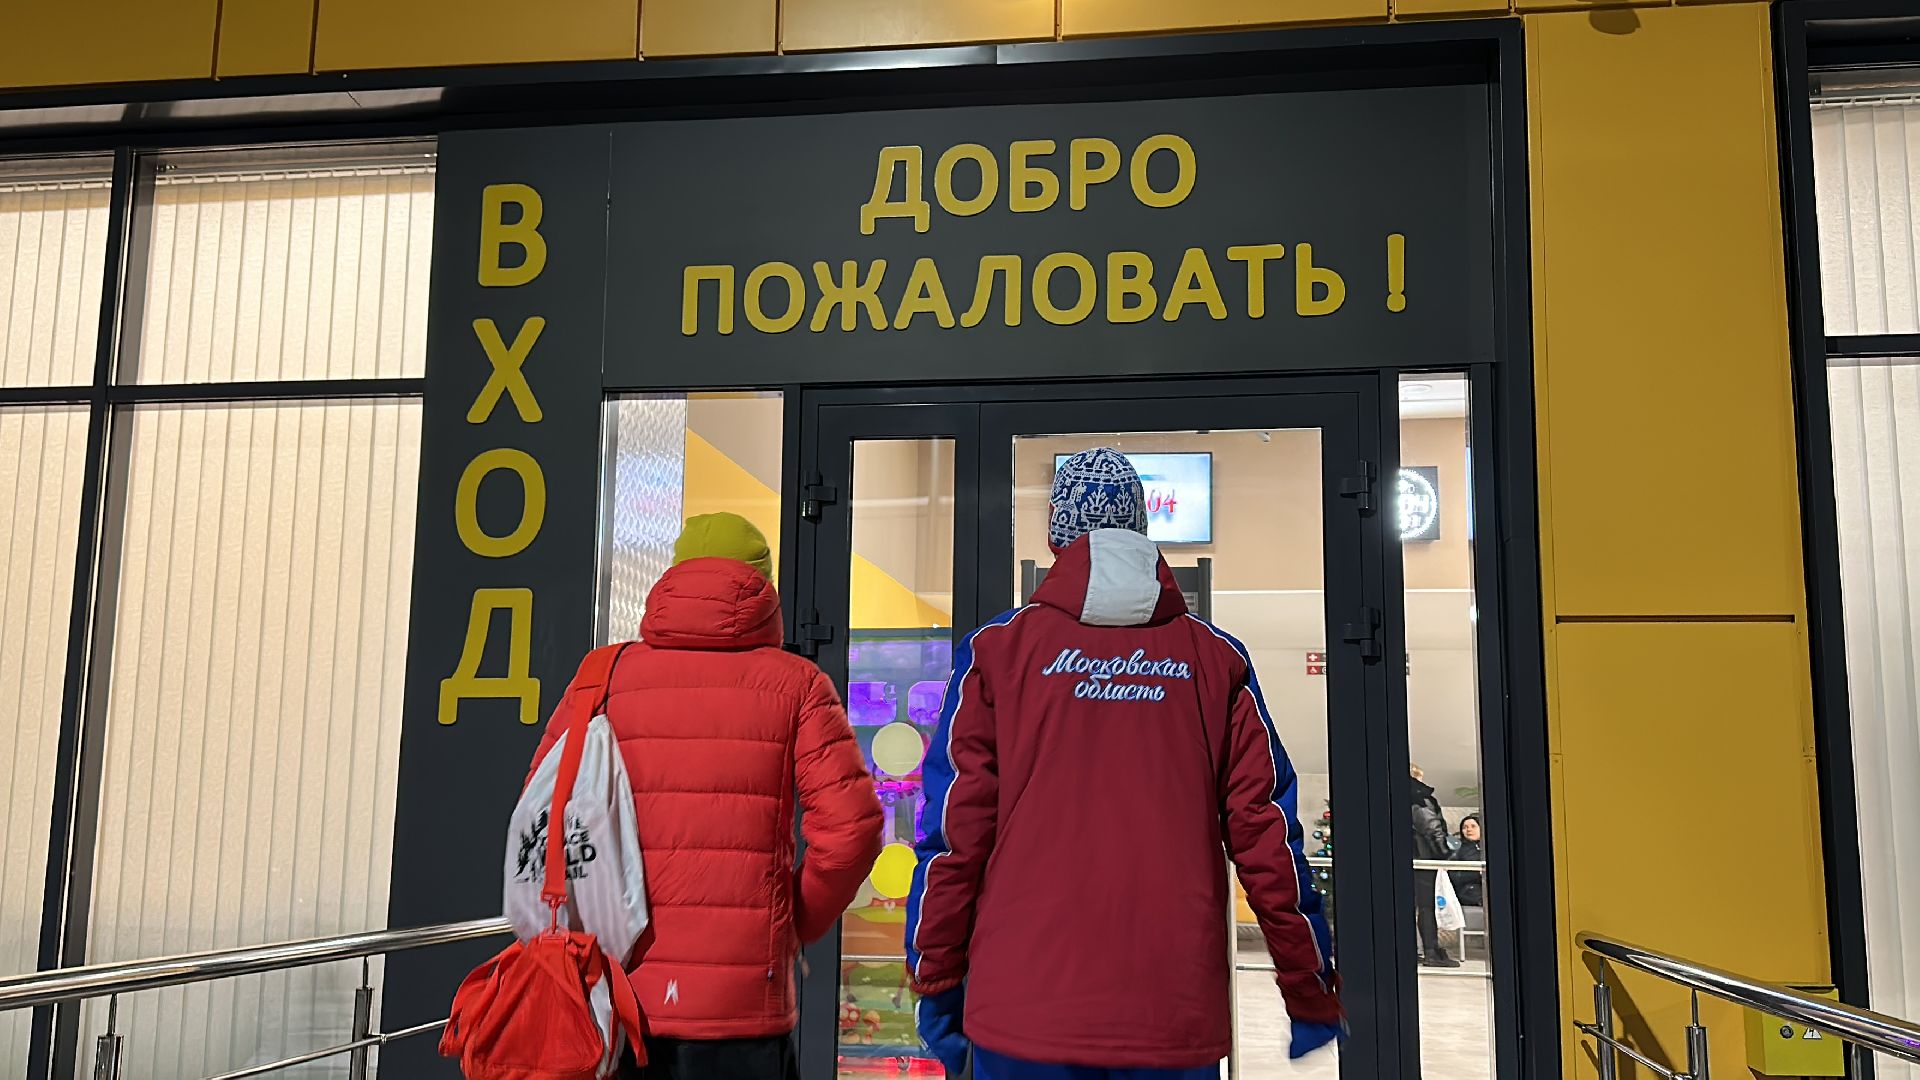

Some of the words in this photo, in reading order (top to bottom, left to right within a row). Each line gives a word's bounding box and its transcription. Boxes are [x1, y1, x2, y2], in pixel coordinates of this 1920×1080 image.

[859, 134, 1198, 235] ДОБРО
[681, 242, 1347, 336] ПОЖАЛОВАТЬ
[437, 183, 548, 726] ВХОД
[1041, 647, 1191, 680] Московская
[1073, 673, 1166, 701] область
[565, 844, 597, 866] LD
